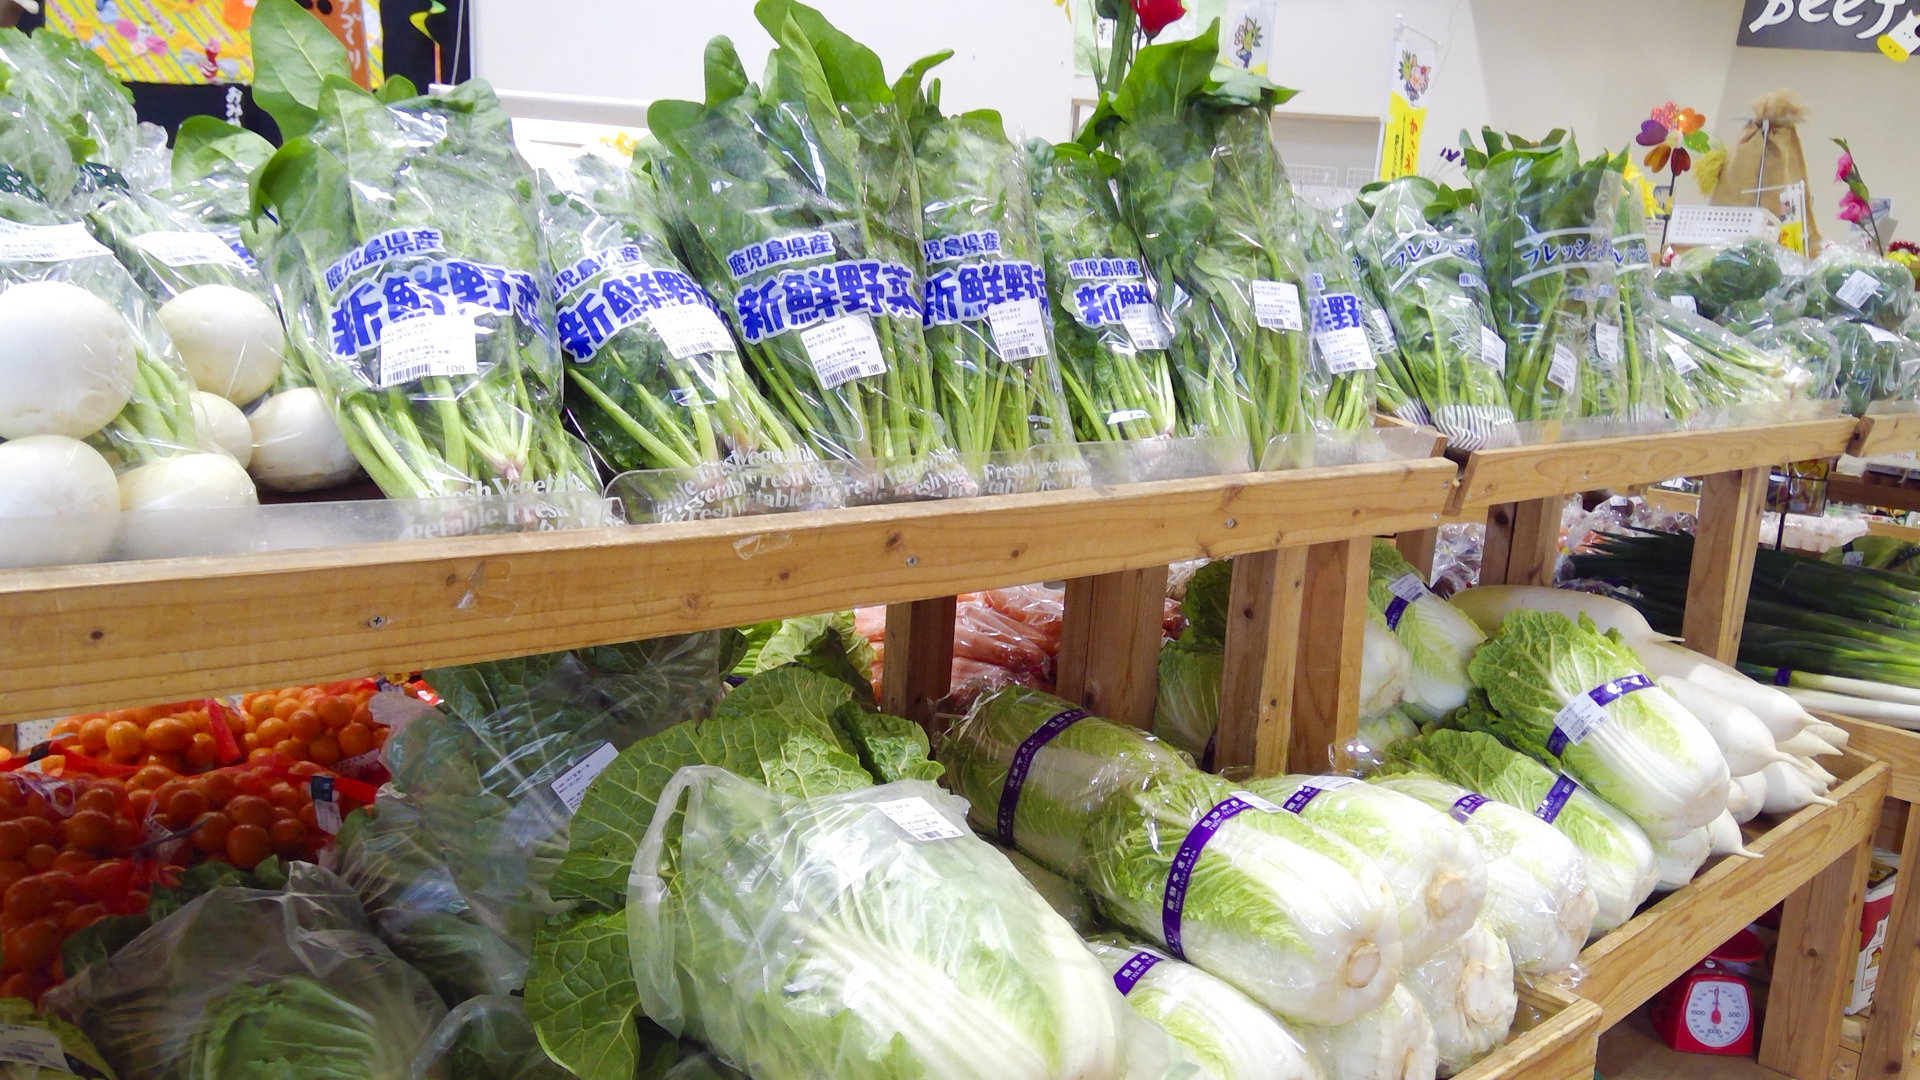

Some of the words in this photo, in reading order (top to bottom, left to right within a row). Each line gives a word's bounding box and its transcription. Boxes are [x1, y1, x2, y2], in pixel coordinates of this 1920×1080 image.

[326, 229, 440, 292] 鹿児島県産
[729, 234, 833, 277] 鹿児島県産
[1070, 261, 1151, 277] 鹿児島県産
[737, 262, 923, 340] 新鮮野菜
[446, 364, 465, 373] 100
[867, 363, 880, 374] 100
[1166, 846, 1191, 911] 新鮮やさい
